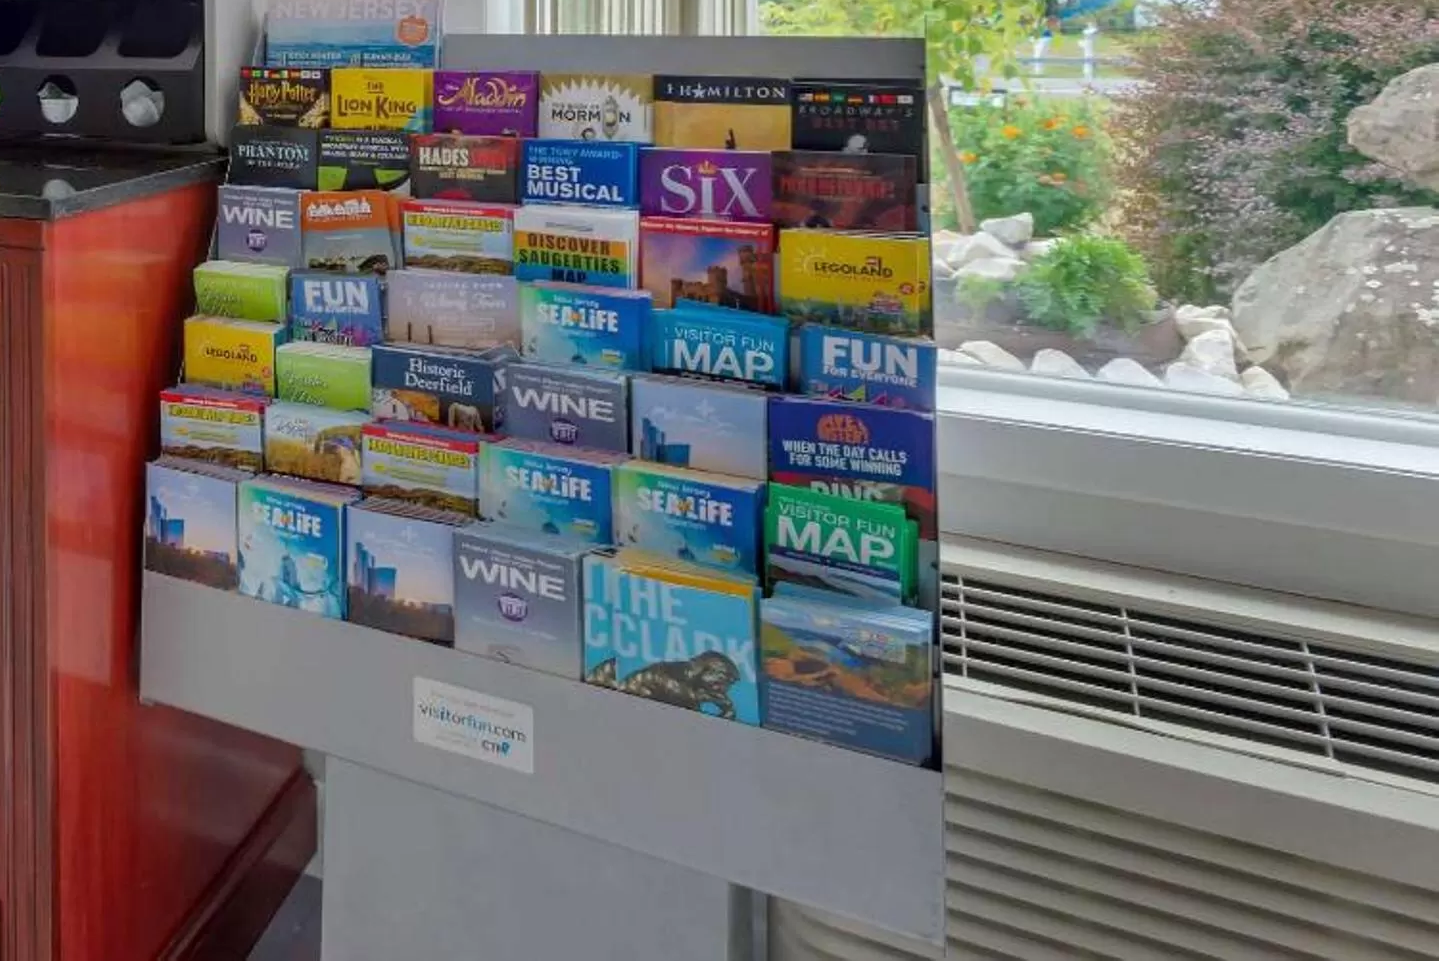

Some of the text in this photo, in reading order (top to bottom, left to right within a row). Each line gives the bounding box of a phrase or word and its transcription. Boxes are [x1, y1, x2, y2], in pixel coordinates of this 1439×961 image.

[274, 0, 329, 19] NEW
[438, 77, 527, 108] Aladdin
[680, 83, 786, 98] HAMILTON
[337, 95, 417, 119] LION KING
[551, 107, 632, 125] MORMON
[527, 163, 581, 183] BEST
[527, 179, 625, 203] MUSICAL
[222, 204, 295, 229] WINE
[527, 232, 611, 256] DISCOVER
[519, 248, 621, 275] SAUGERTIES
[814, 257, 894, 279] LEGOLAND
[551, 267, 588, 284] MAP
[304, 280, 369, 309] FUN
[536, 302, 576, 327] SEA
[674, 326, 774, 353] VISITOR FUN
[205, 347, 258, 363] LEGOLAND
[673, 339, 775, 382] MAP
[823, 335, 918, 379] FUN
[409, 357, 466, 380] Historic
[823, 365, 918, 388] FOR EVERYONE
[404, 371, 473, 396] Deerfield
[511, 385, 616, 423] WINE
[782, 439, 908, 465] WHEN THE DAY CALLS
[789, 452, 902, 477] FOR SOME WINNING
[506, 465, 546, 491] SEA
[636, 486, 681, 516] SEA
[779, 501, 850, 528] VISITOR
[856, 518, 896, 539] FUN
[778, 515, 895, 565] MAP
[459, 555, 566, 602] WINE
[417, 703, 527, 743] visitorfun.com
